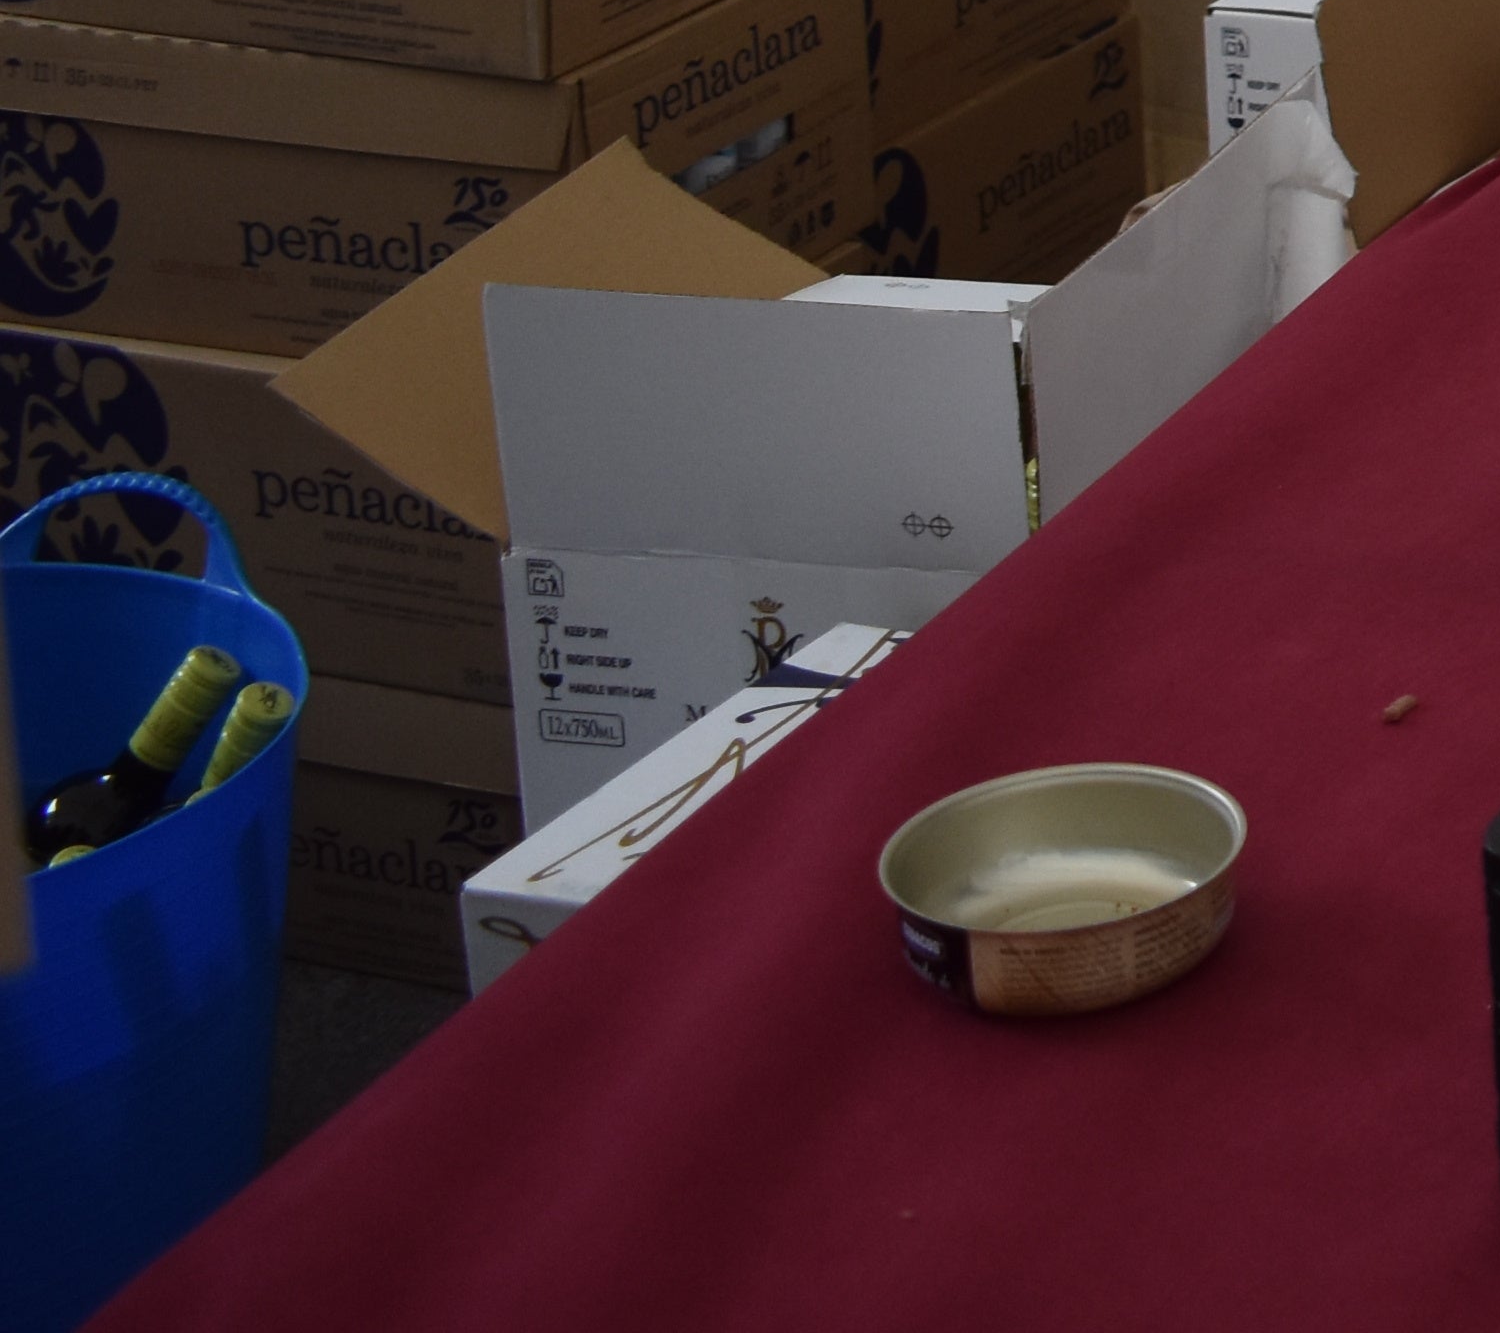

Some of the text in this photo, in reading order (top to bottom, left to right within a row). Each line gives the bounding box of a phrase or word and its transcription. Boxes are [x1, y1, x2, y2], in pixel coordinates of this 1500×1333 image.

[632, 14, 823, 150] peñaclara
[976, 109, 1134, 234] peñaclara
[564, 625, 590, 638] KEEP
[567, 653, 596, 666] RIGHT
[569, 683, 605, 696] HANDLE
[548, 715, 617, 740] 12x750ML
